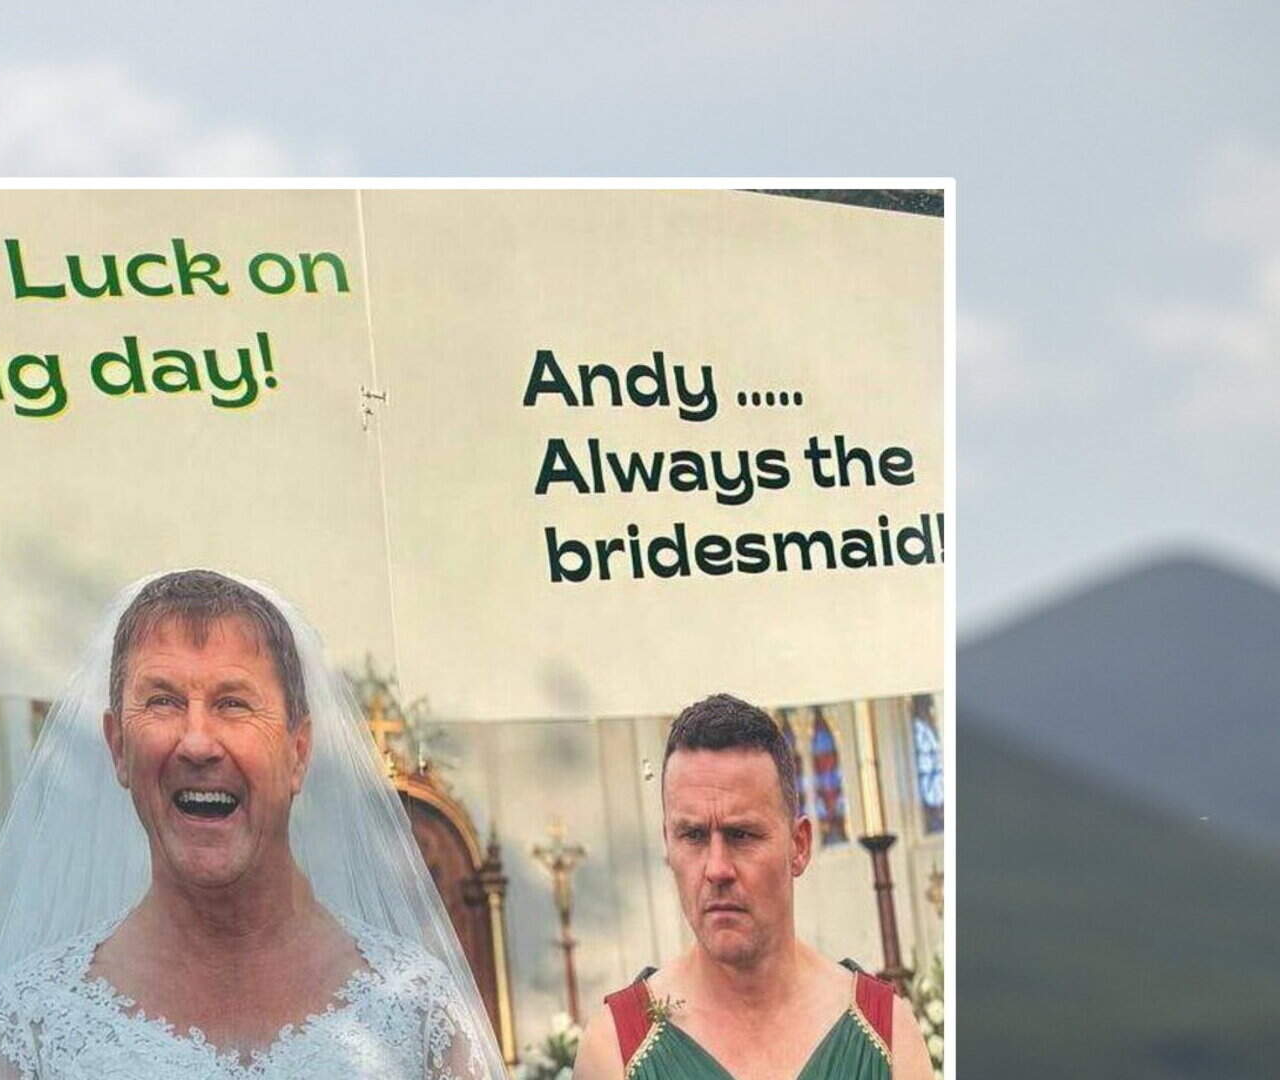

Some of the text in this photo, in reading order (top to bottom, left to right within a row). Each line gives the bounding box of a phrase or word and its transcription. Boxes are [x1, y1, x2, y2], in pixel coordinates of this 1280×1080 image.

[3, 238, 231, 300] Luck
[248, 251, 351, 295] on
[90, 331, 279, 410] day!
[523, 349, 718, 422] Andy
[534, 435, 915, 506] Always the
[544, 513, 943, 583] bridesmaid!
